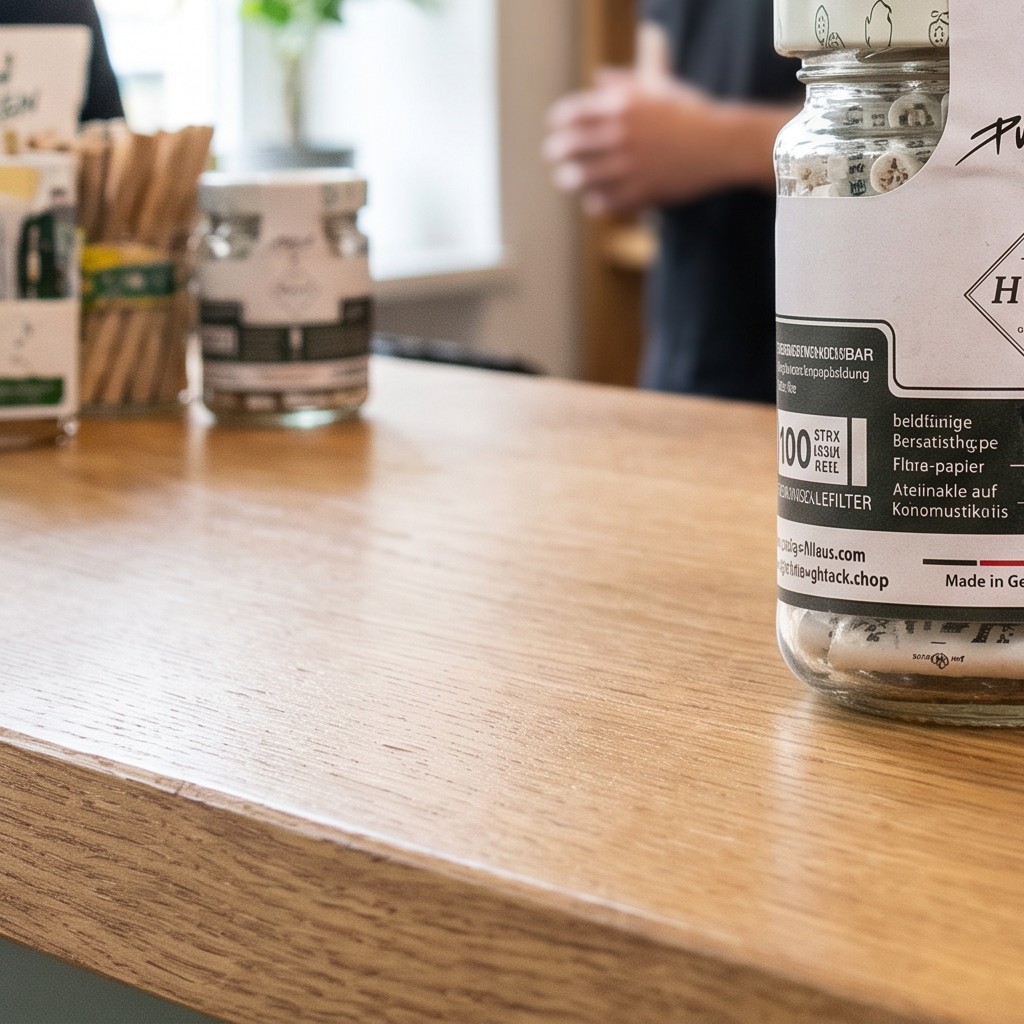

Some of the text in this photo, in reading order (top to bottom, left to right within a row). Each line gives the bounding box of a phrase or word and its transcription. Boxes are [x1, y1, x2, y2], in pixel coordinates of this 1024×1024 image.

[780, 426, 811, 469] 100
[972, 484, 998, 498] auf
[945, 574, 986, 588] Made
[990, 574, 1004, 588] in
